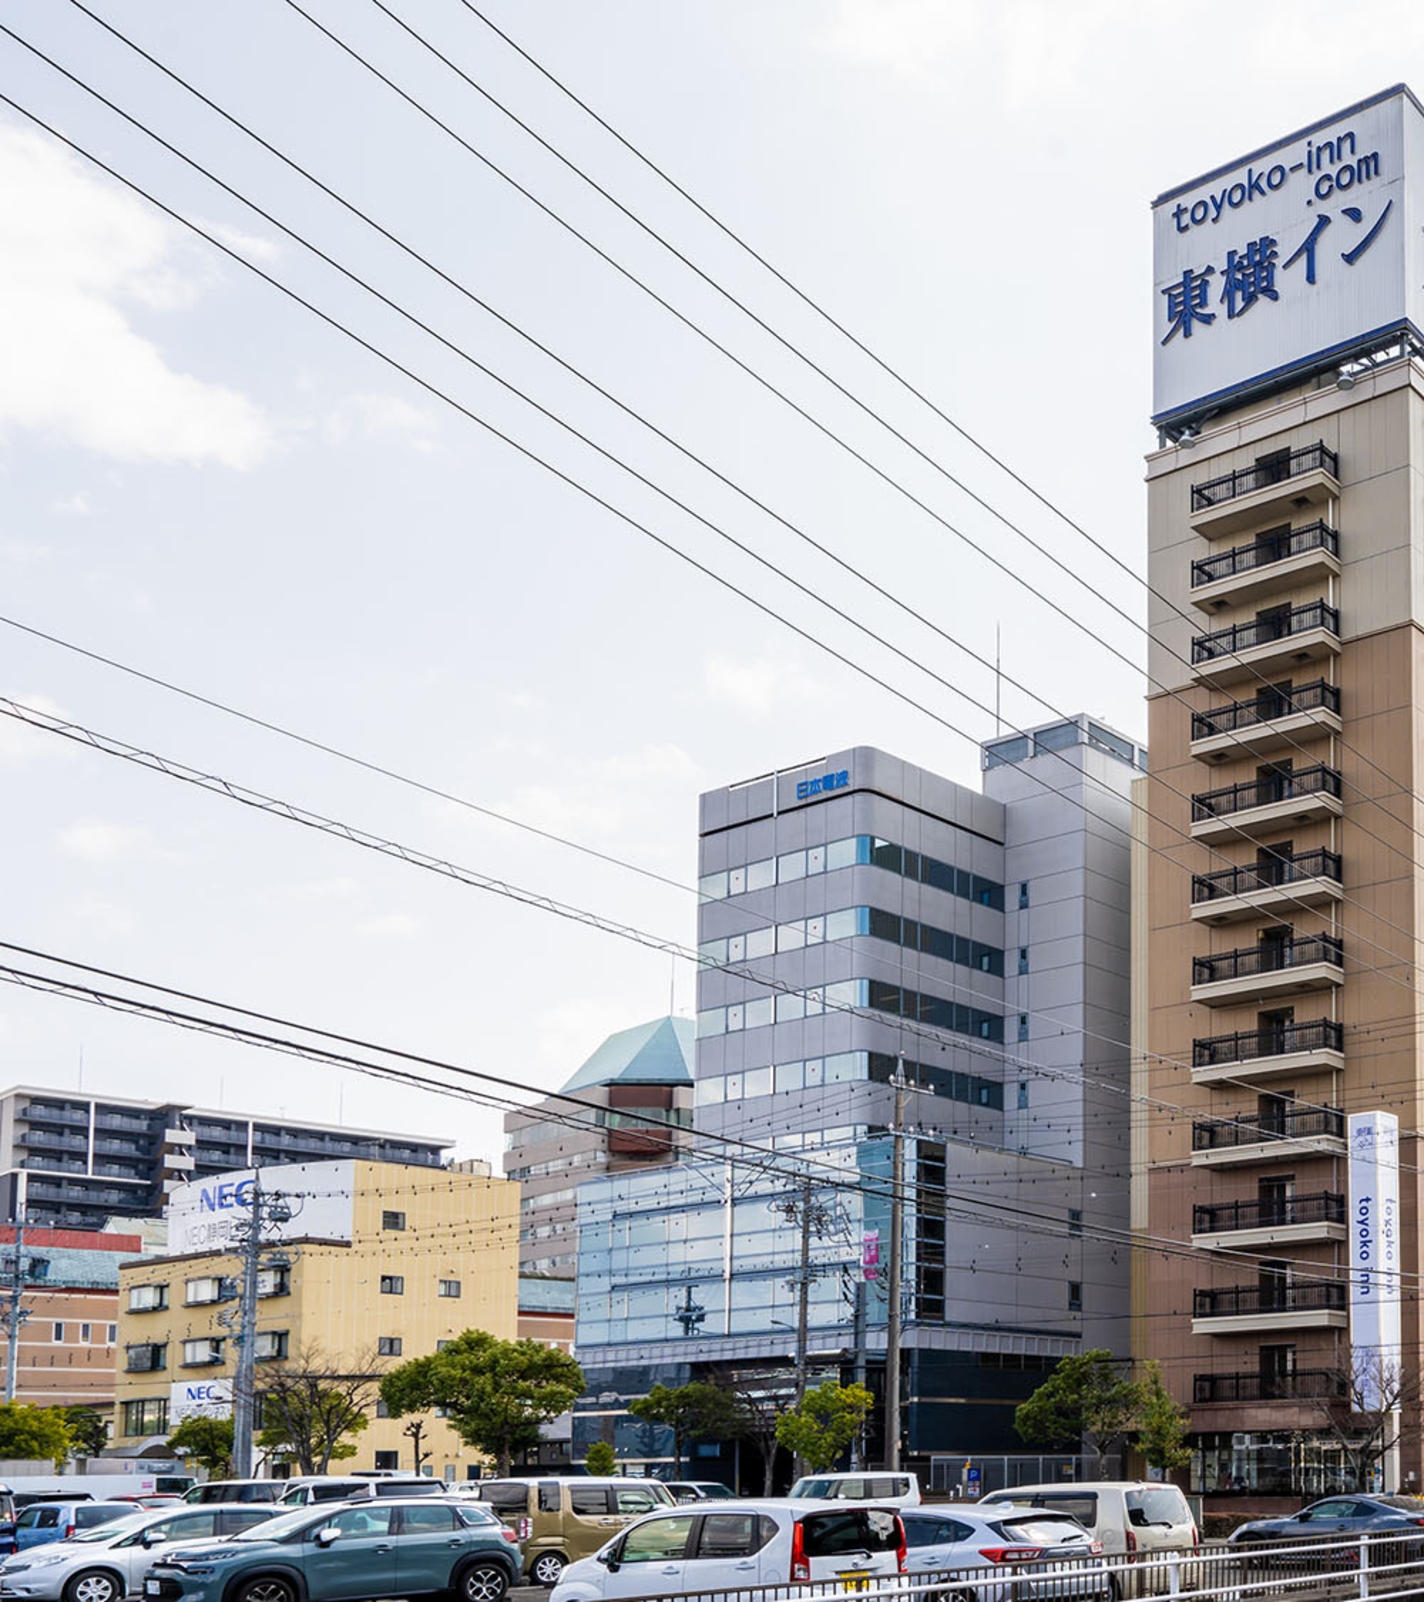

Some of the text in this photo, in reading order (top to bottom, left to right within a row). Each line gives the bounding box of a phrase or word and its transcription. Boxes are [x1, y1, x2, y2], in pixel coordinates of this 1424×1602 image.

[1172, 131, 1355, 233] toyoko-inn
[1306, 152, 1379, 206] .com
[1161, 199, 1392, 346] 東横イン
[201, 1180, 256, 1212] NEC
[1356, 1196, 1373, 1295] toyoko inn
[1384, 1199, 1396, 1260] toyoko
[187, 1385, 216, 1400] NEC
